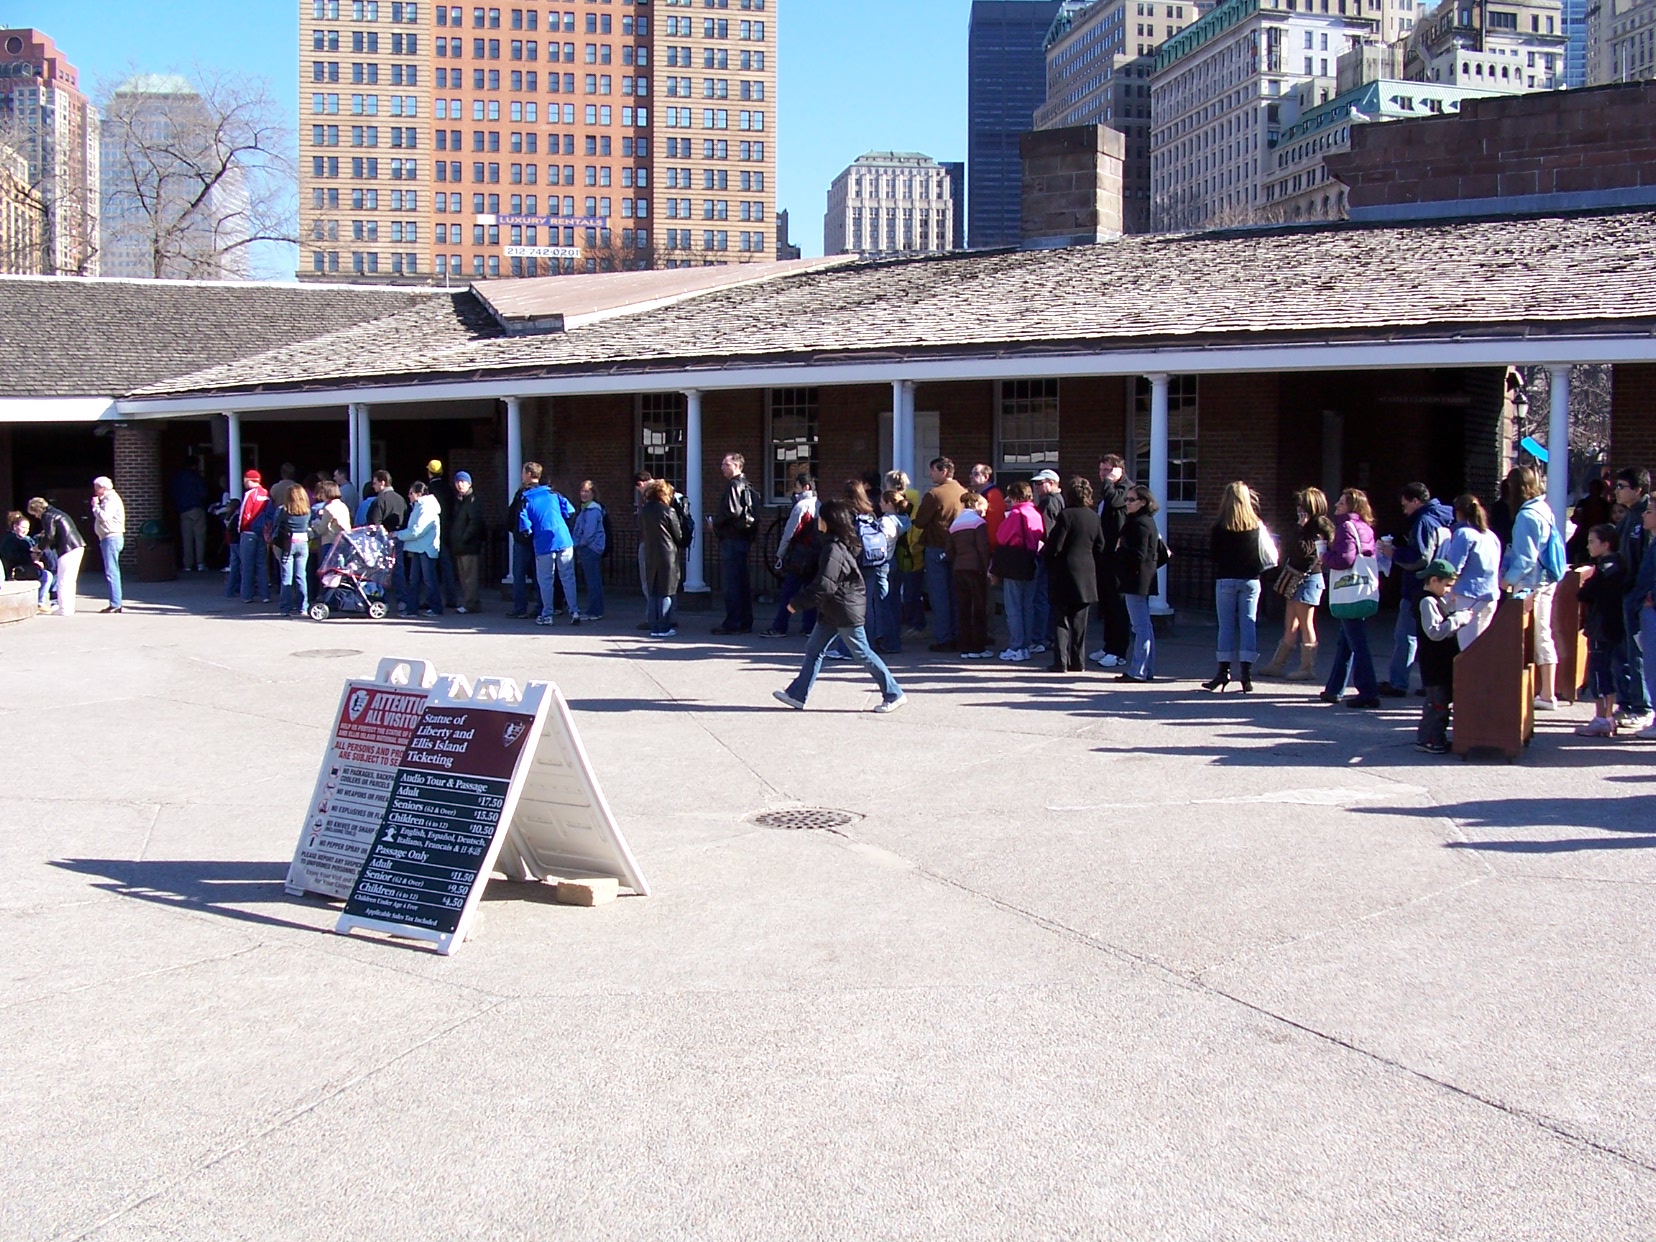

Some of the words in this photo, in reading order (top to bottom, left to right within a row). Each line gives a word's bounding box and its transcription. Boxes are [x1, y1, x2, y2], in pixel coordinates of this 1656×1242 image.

[550, 218, 603, 226] RENTALS
[508, 248, 579, 256] 212-742-0201
[365, 710, 383, 723] ALL
[422, 714, 452, 724] Statue
[453, 715, 468, 726] of
[417, 726, 453, 739] Liberty
[453, 729, 475, 739] and
[335, 741, 346, 749] ALL
[347, 743, 375, 754] PERSONS
[376, 747, 389, 756] AND
[411, 738, 433, 749] Ellis
[434, 741, 468, 752] Island
[338, 751, 352, 759] ARE
[352, 753, 379, 763] SUBJECT
[381, 756, 389, 765] TO
[406, 751, 454, 768] Ticketing
[350, 769, 374, 779] PACKAGES,
[340, 776, 361, 784] COOLERS
[369, 780, 390, 789] PARCELS
[400, 773, 425, 784] Audio
[426, 776, 446, 786] Tour
[446, 779, 454, 788] &
[455, 780, 488, 793] Passage
[344, 790, 367, 799] WEAPONS
[396, 786, 419, 796] Adult
[478, 797, 503, 808] $17.50
[339, 806, 367, 816] EXPLOSIVES
[392, 799, 424, 811] Seniors
[440, 808, 457, 816] Over)
[474, 810, 499, 821] $15.50
[334, 821, 351, 829] KNIVES
[358, 825, 375, 834] SHARP
[388, 813, 425, 826] Children
[469, 824, 495, 835] $10.50
[400, 827, 427, 838] English,
[427, 831, 456, 843] Español,
[456, 835, 487, 847] Deutsch,
[326, 841, 344, 849] PEPPER
[345, 844, 360, 852] SPRAY
[375, 845, 407, 858] Passage
[408, 850, 429, 862] Only
[396, 837, 423, 847] Italiano,
[460, 845, 482, 856] 日本語
[301, 851, 317, 859] PLEASE
[317, 854, 334, 862] REPORT
[369, 859, 393, 869] Adult
[451, 871, 474, 882] $11.50
[364, 870, 392, 881] Senior
[407, 878, 424, 887] Over)
[448, 884, 469, 895] $9.50
[358, 882, 395, 896] Children
[442, 896, 464, 908] $4.50
[354, 894, 376, 904] Children
[376, 898, 393, 907] Under
[407, 903, 419, 911] Free
[365, 908, 392, 918] Applicable
[393, 912, 405, 920] Sales
[404, 914, 414, 922] Tax
[414, 916, 438, 926] Included
